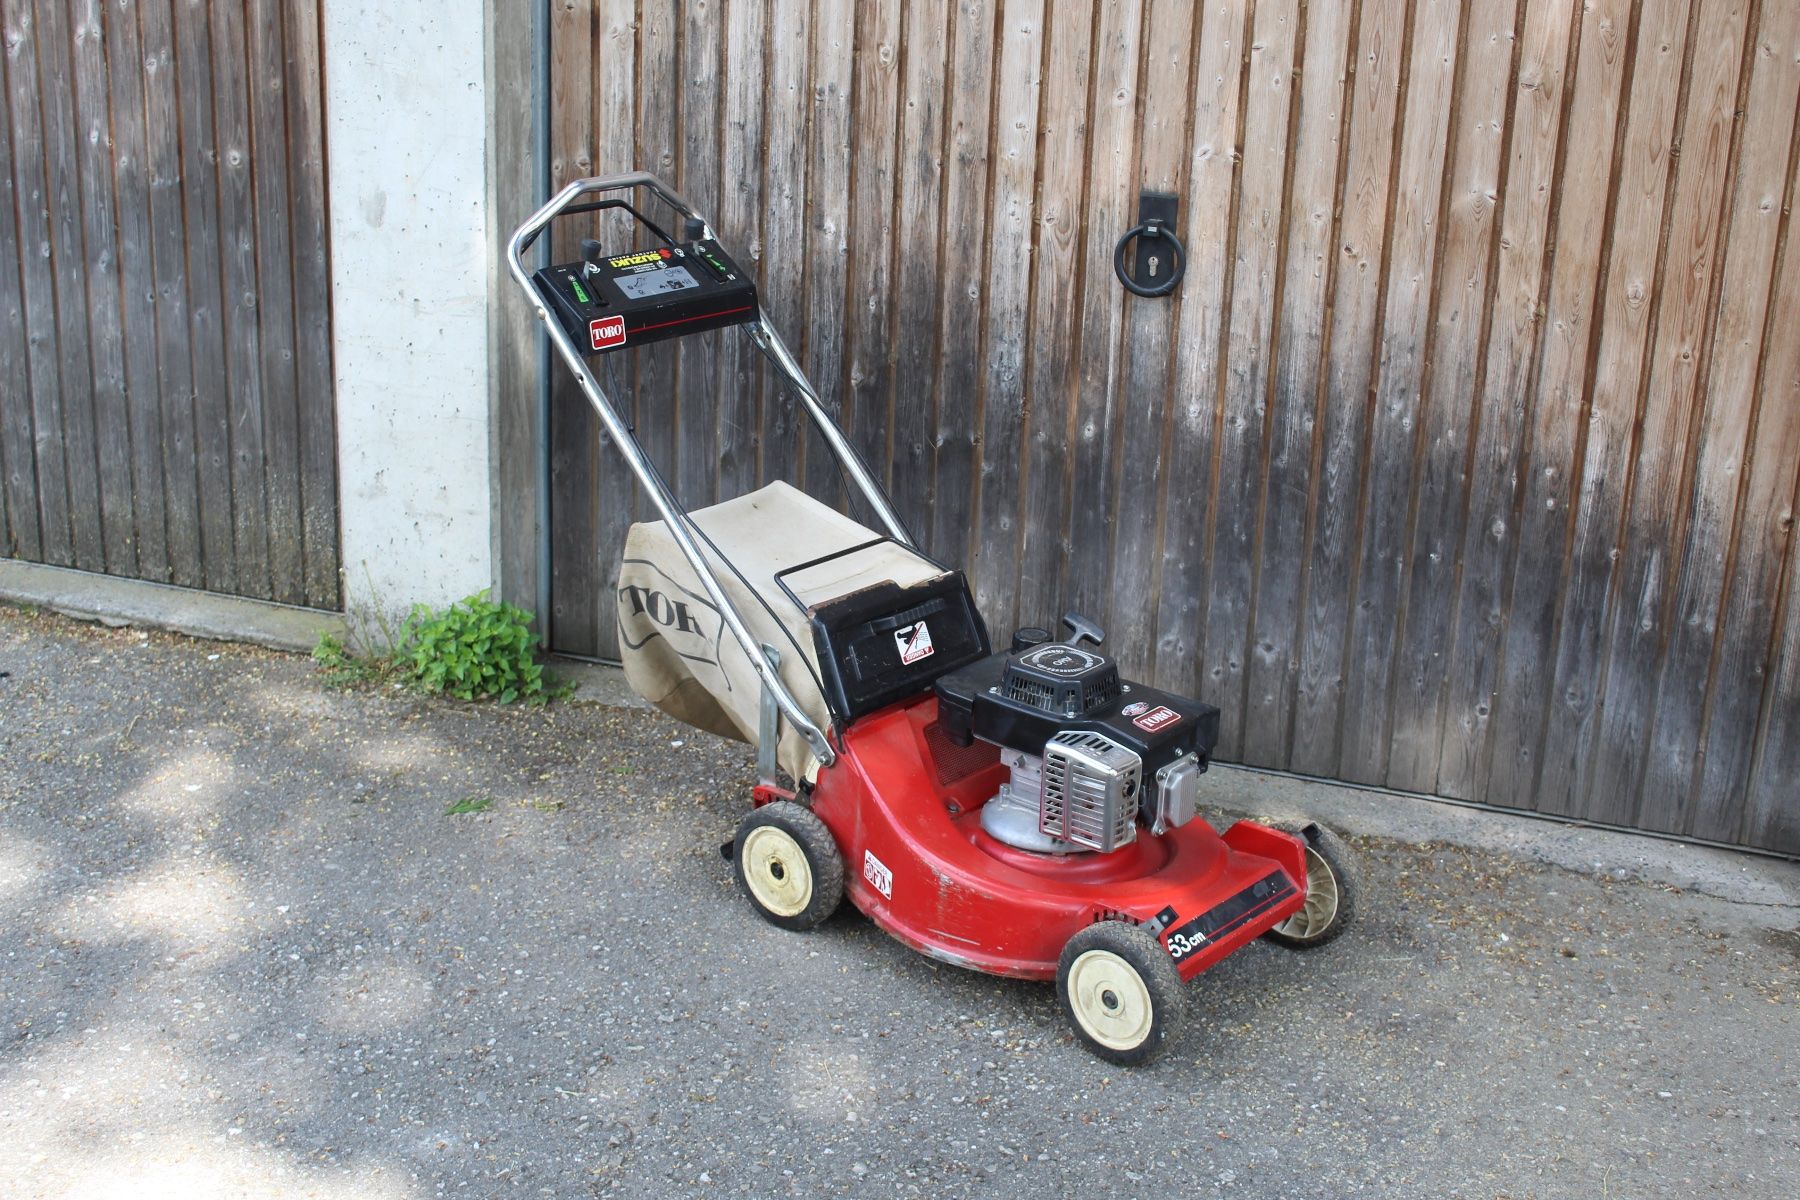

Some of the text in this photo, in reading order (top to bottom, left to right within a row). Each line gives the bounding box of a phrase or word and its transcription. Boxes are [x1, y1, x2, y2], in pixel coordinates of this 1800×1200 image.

[610, 253, 661, 268] SUZUKI
[592, 324, 622, 340] TORO
[1140, 709, 1173, 727] TORO
